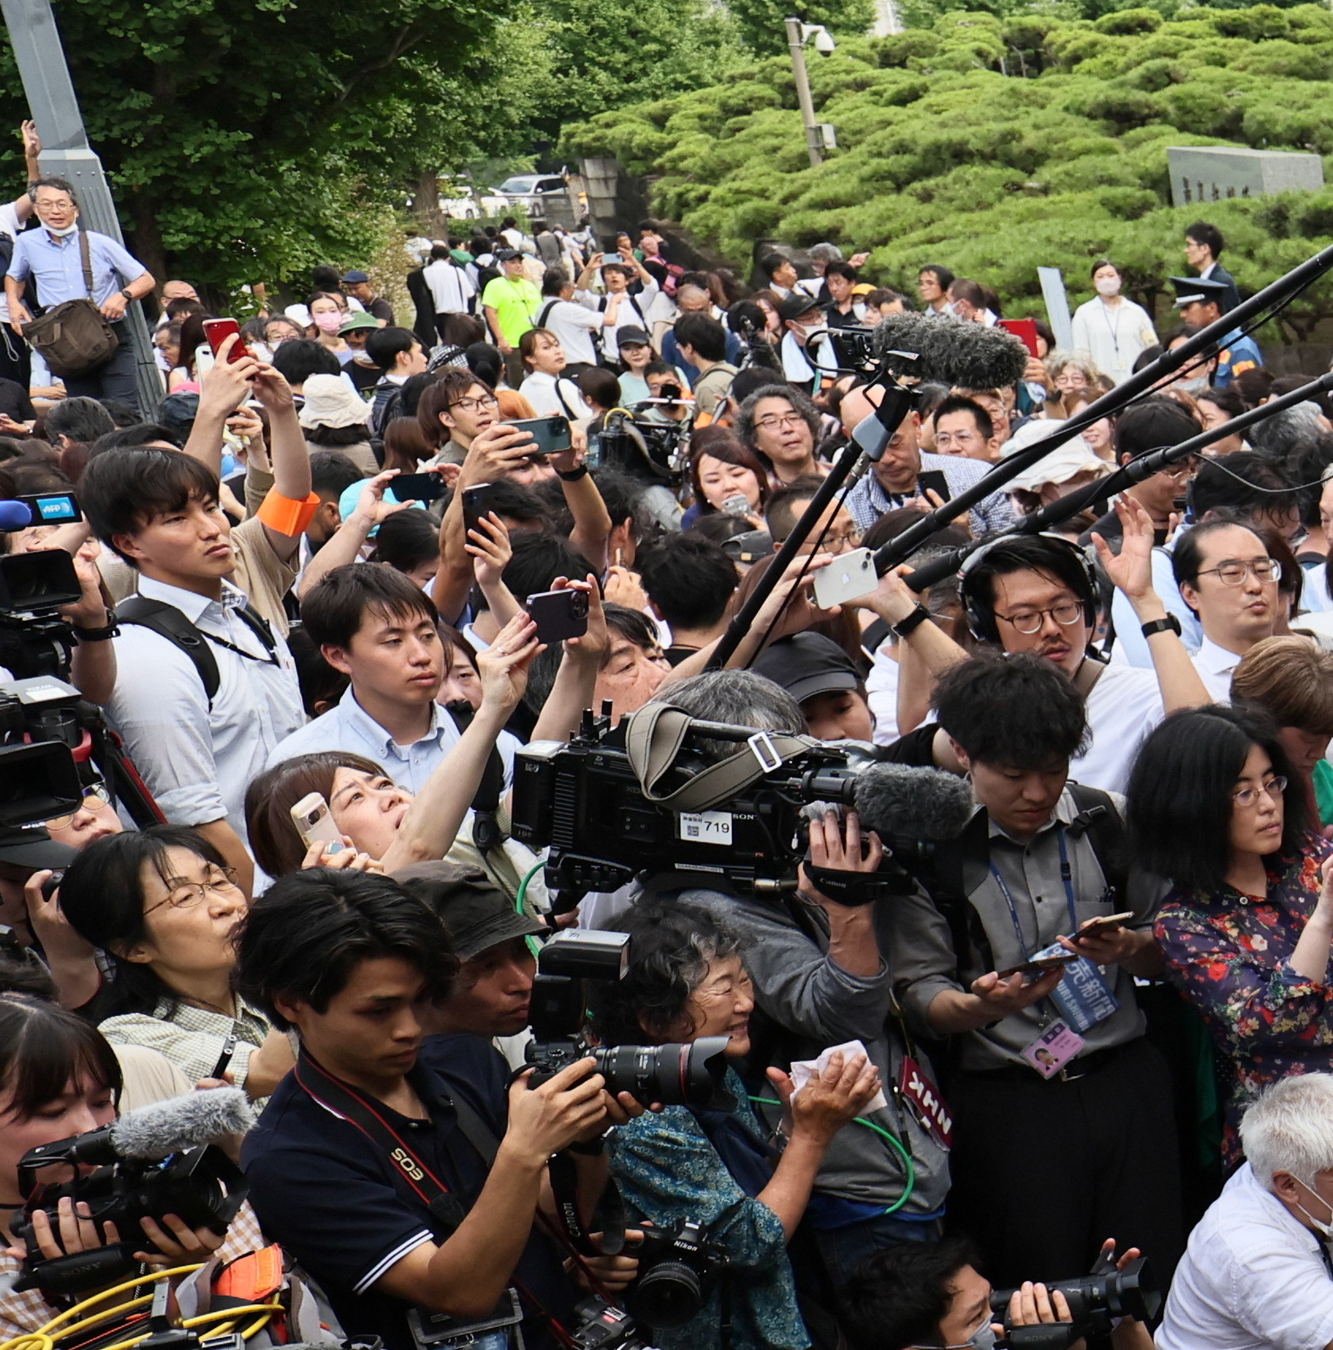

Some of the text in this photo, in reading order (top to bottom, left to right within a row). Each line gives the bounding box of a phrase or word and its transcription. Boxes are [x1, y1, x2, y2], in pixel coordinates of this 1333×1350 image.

[43, 504, 60, 513] AFP
[704, 820, 730, 833] 719
[820, 876, 847, 888] Canon
[908, 1071, 952, 1135] NHK
[391, 1147, 424, 1182] EOS
[562, 1202, 581, 1238] Canon
[674, 1239, 698, 1252] Nikon
